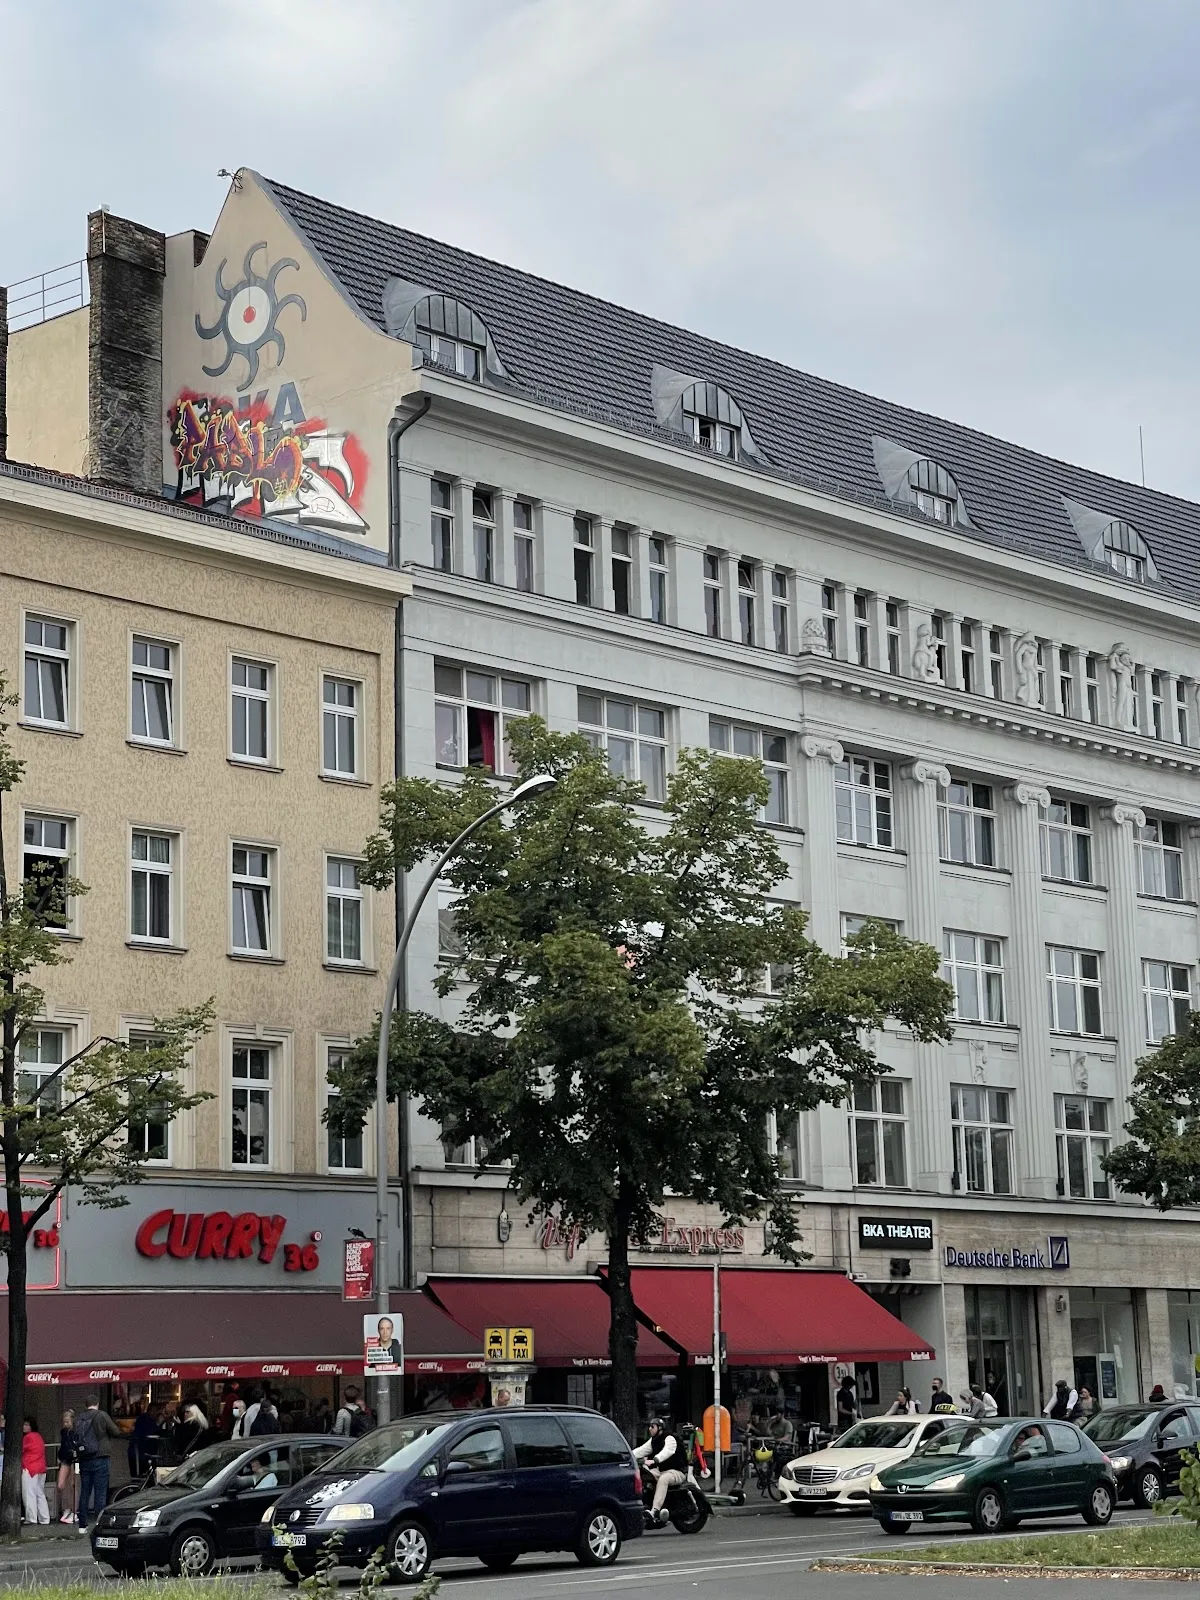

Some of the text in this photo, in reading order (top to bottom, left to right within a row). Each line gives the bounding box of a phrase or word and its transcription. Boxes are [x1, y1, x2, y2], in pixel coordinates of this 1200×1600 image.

[862, 1223, 932, 1239] BKA THEATER
[135, 1208, 320, 1272] CURRY 36
[662, 1217, 745, 1256] Express
[944, 1246, 1045, 1268] Deutsche Bank
[512, 1348, 529, 1359] TAXI
[206, 1366, 229, 1374] CURRY
[262, 1365, 284, 1373] CURRY
[316, 1363, 337, 1372] CURRY
[418, 1362, 438, 1370] CURRY
[89, 1370, 113, 1379] CURRY
[149, 1368, 172, 1377] CURRY
[28, 1373, 52, 1382] CURRY
